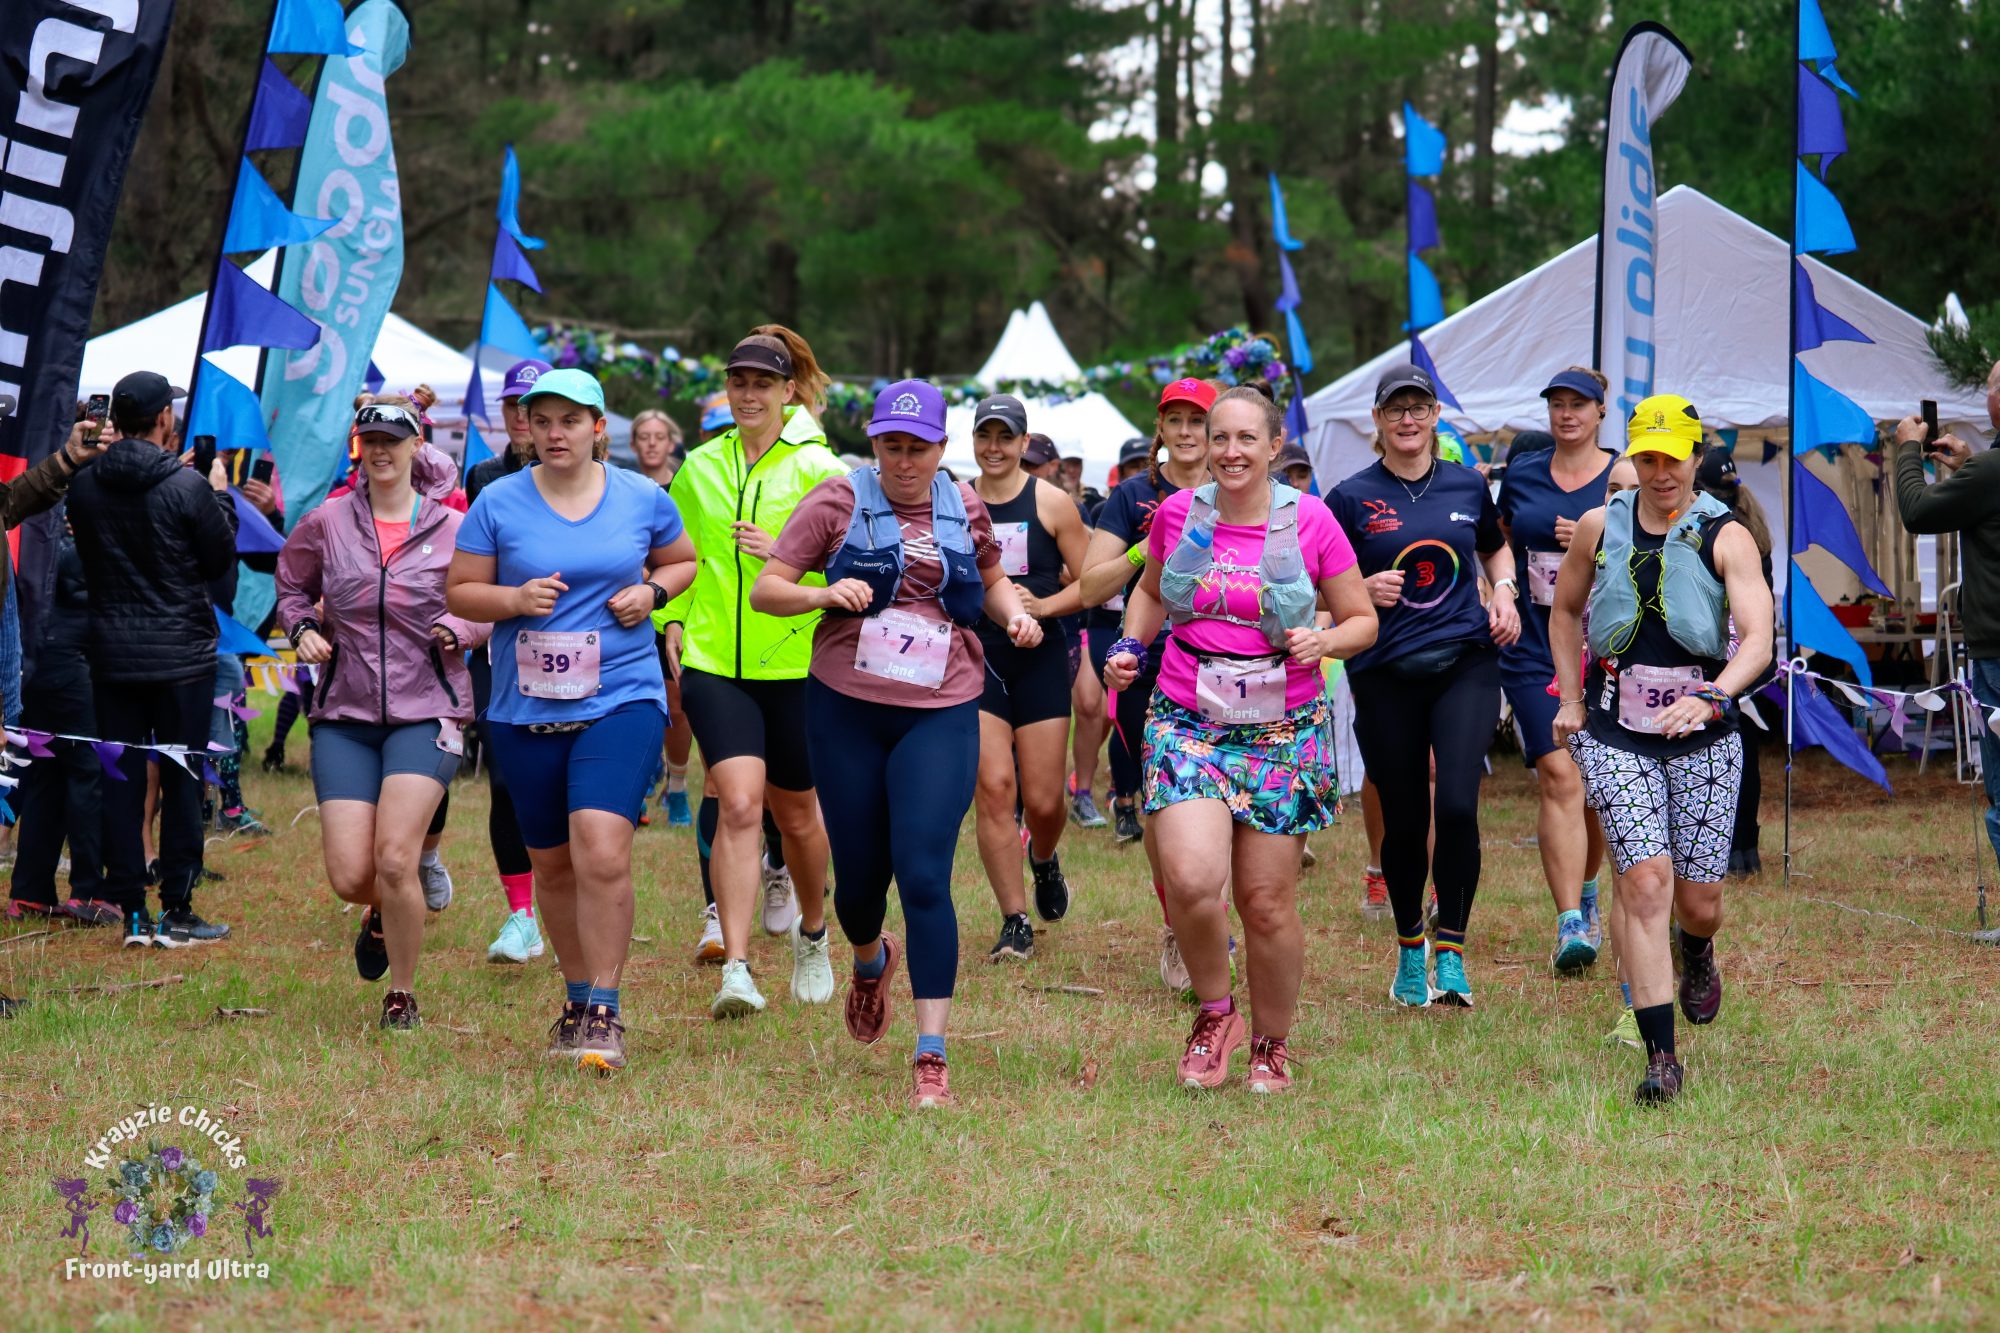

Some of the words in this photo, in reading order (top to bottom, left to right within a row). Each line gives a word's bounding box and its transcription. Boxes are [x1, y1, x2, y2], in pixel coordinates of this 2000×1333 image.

[899, 634, 914, 654] 7
[542, 653, 570, 673] 39
[884, 661, 915, 678] Jane
[531, 681, 584, 694] Catherine
[1235, 679, 1246, 698] 1
[1645, 689, 1676, 708] 36
[1222, 706, 1260, 719] Maria
